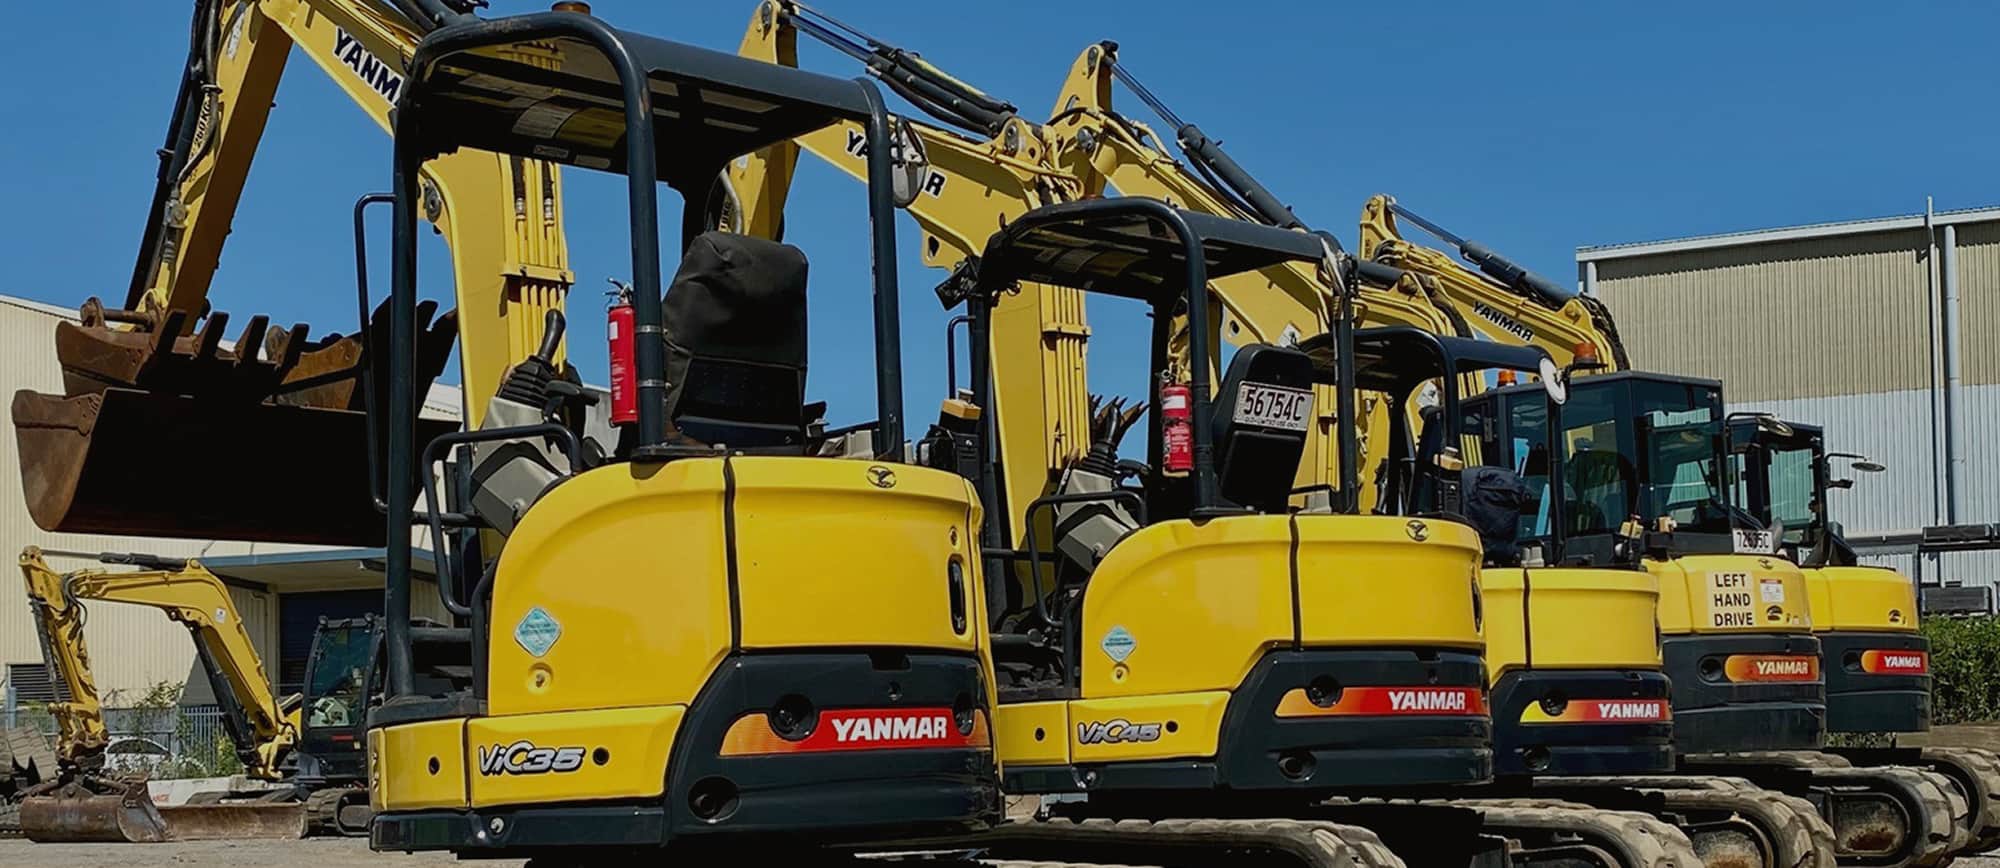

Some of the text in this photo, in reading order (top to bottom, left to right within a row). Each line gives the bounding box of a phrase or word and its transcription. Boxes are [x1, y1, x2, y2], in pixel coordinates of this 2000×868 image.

[333, 27, 401, 107] YANM
[1473, 301, 1534, 341] YANMAR
[1244, 388, 1305, 421] 56754C
[1714, 573, 1746, 588] LEFT
[1714, 592, 1751, 607] HAND
[1714, 612, 1753, 627] DRIVE
[1756, 661, 1809, 675] YANMAR
[1884, 656, 1921, 668] YANMAR
[1388, 690, 1466, 711] YANMAR
[1598, 703, 1660, 718] YANMAR
[831, 716, 948, 742] YANMAR
[478, 740, 585, 776] ViC35
